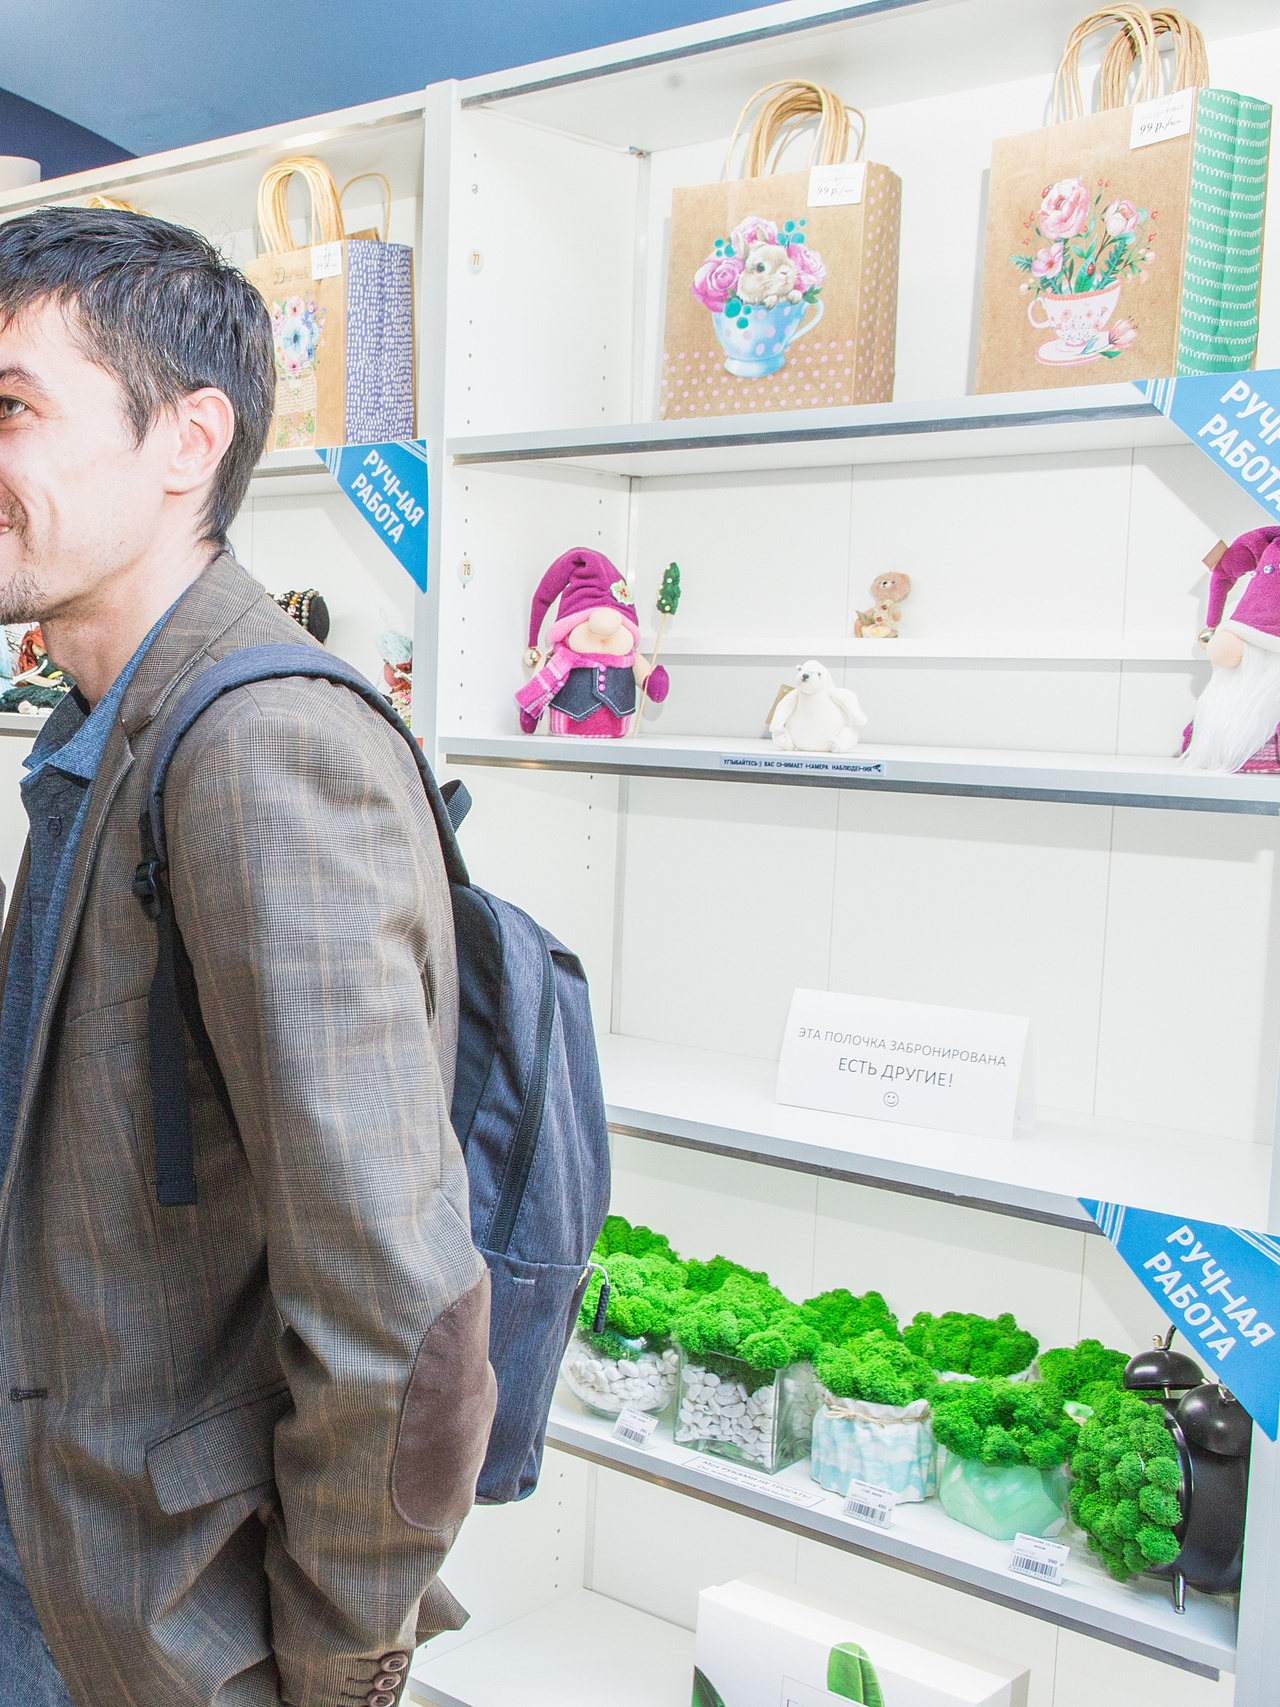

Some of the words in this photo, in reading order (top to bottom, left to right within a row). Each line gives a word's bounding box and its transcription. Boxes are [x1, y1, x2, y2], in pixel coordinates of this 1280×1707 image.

[1140, 122, 1153, 135] 99
[473, 253, 480, 266] 77
[363, 449, 425, 527] РУЧНАЯ
[351, 473, 405, 544] РАБОТА
[463, 563, 471, 576] 78
[764, 760, 774, 768] ВАС
[776, 761, 803, 769] СНИМАЕТ
[805, 762, 829, 770] КАМЕРА
[832, 764, 872, 773] НАБЛЮДЕНИЯ
[798, 1027, 821, 1041] ЭТА
[824, 1031, 886, 1050] ПОЛОЧКА
[889, 1040, 1006, 1067] ЗАБРОНИРОВАНА
[838, 1057, 877, 1076] ЕСТЬ
[880, 1064, 953, 1088] ДРУГИЕ!
[1165, 1224, 1276, 1347] РУЧНАЯ
[1143, 1251, 1237, 1361] РАБОТА
[721, 1467, 757, 1481] РУКАМИ
